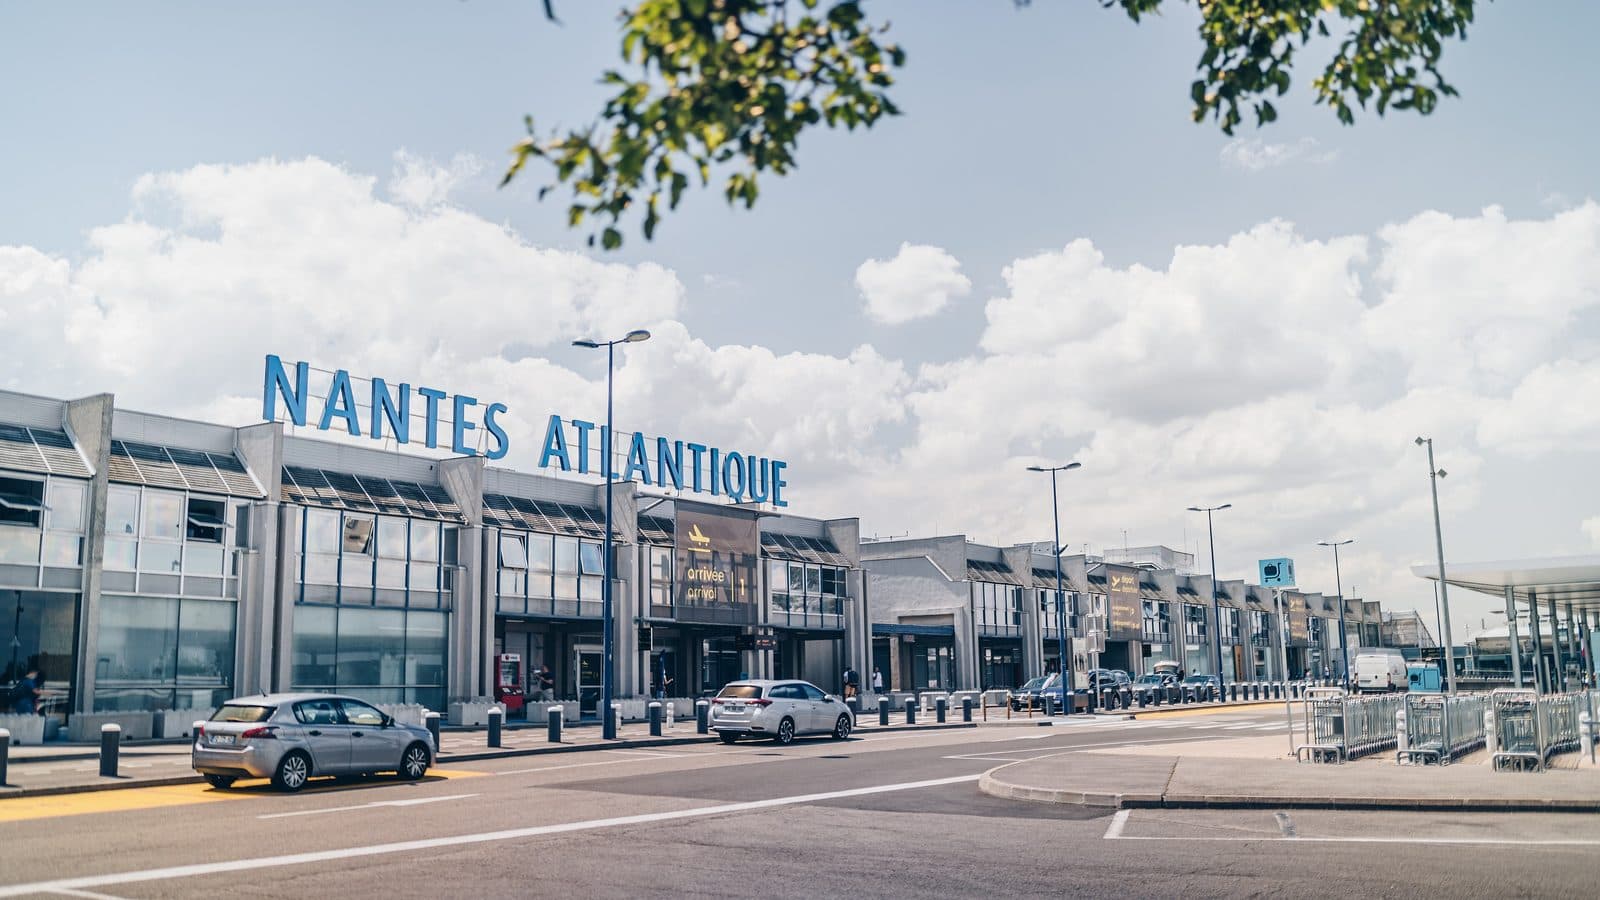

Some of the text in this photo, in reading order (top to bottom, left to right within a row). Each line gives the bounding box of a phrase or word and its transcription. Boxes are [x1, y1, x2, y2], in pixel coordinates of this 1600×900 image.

[263, 354, 788, 507] NANTES ATLANTIQUE
[688, 566, 725, 582] arrivée
[688, 585, 717, 599] arrival
[740, 578, 745, 596] 1
